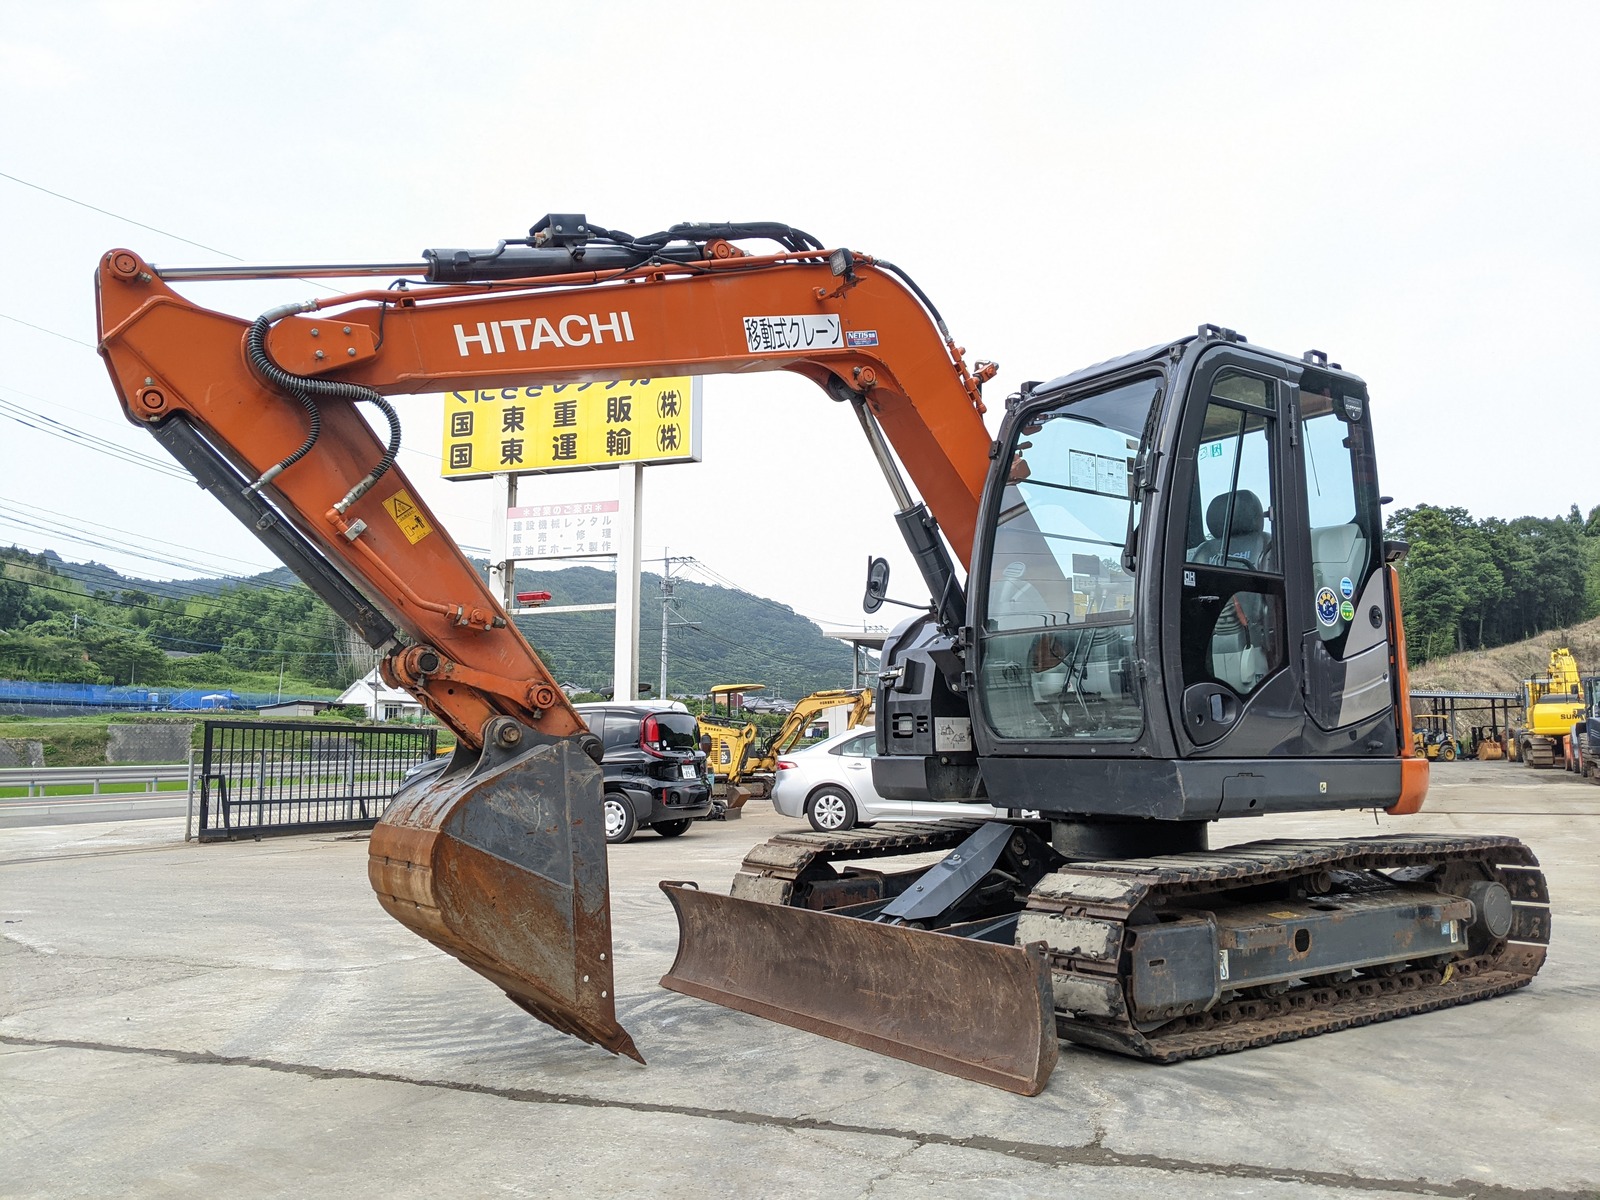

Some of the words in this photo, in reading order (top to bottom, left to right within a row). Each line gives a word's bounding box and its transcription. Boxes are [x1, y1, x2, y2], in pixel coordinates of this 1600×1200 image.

[453, 311, 635, 357] HITACHI
[745, 317, 840, 351] 移動式クレーン
[513, 515, 612, 532] 建設機械レンタル
[512, 541, 612, 557] 高油圧ホース製作
